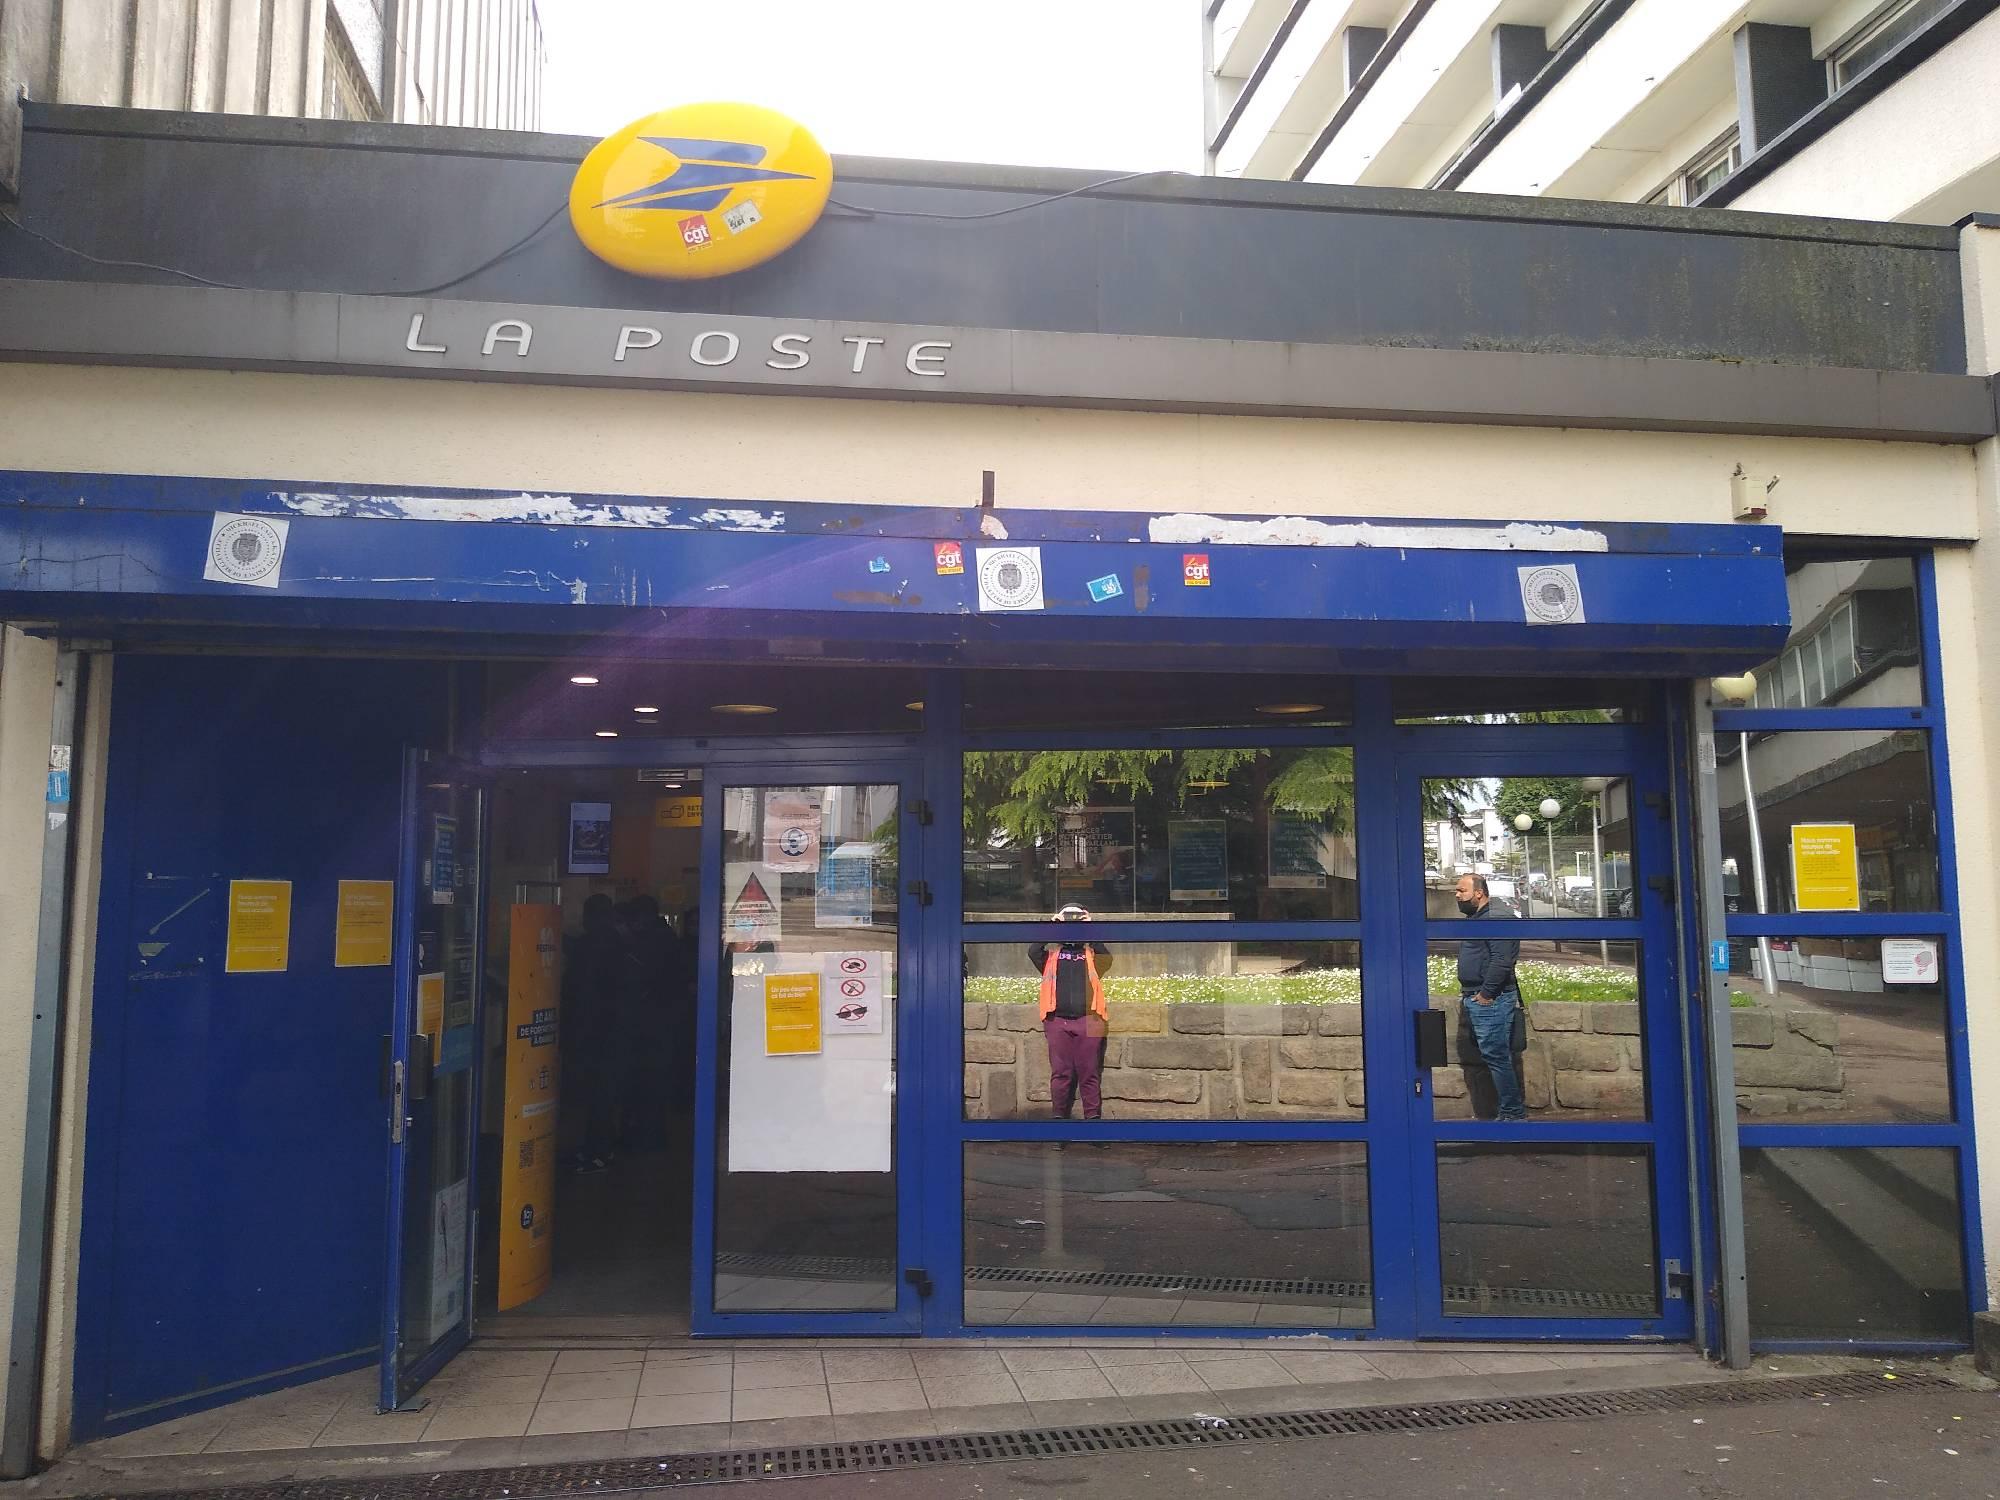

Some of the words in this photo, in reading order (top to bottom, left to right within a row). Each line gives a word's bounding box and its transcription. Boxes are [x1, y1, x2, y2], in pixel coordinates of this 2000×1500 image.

[684, 224, 709, 243] cgt
[405, 313, 535, 357] LA
[614, 326, 953, 377] POSTE
[938, 552, 962, 567] cgt
[1185, 563, 1209, 580] cgt
